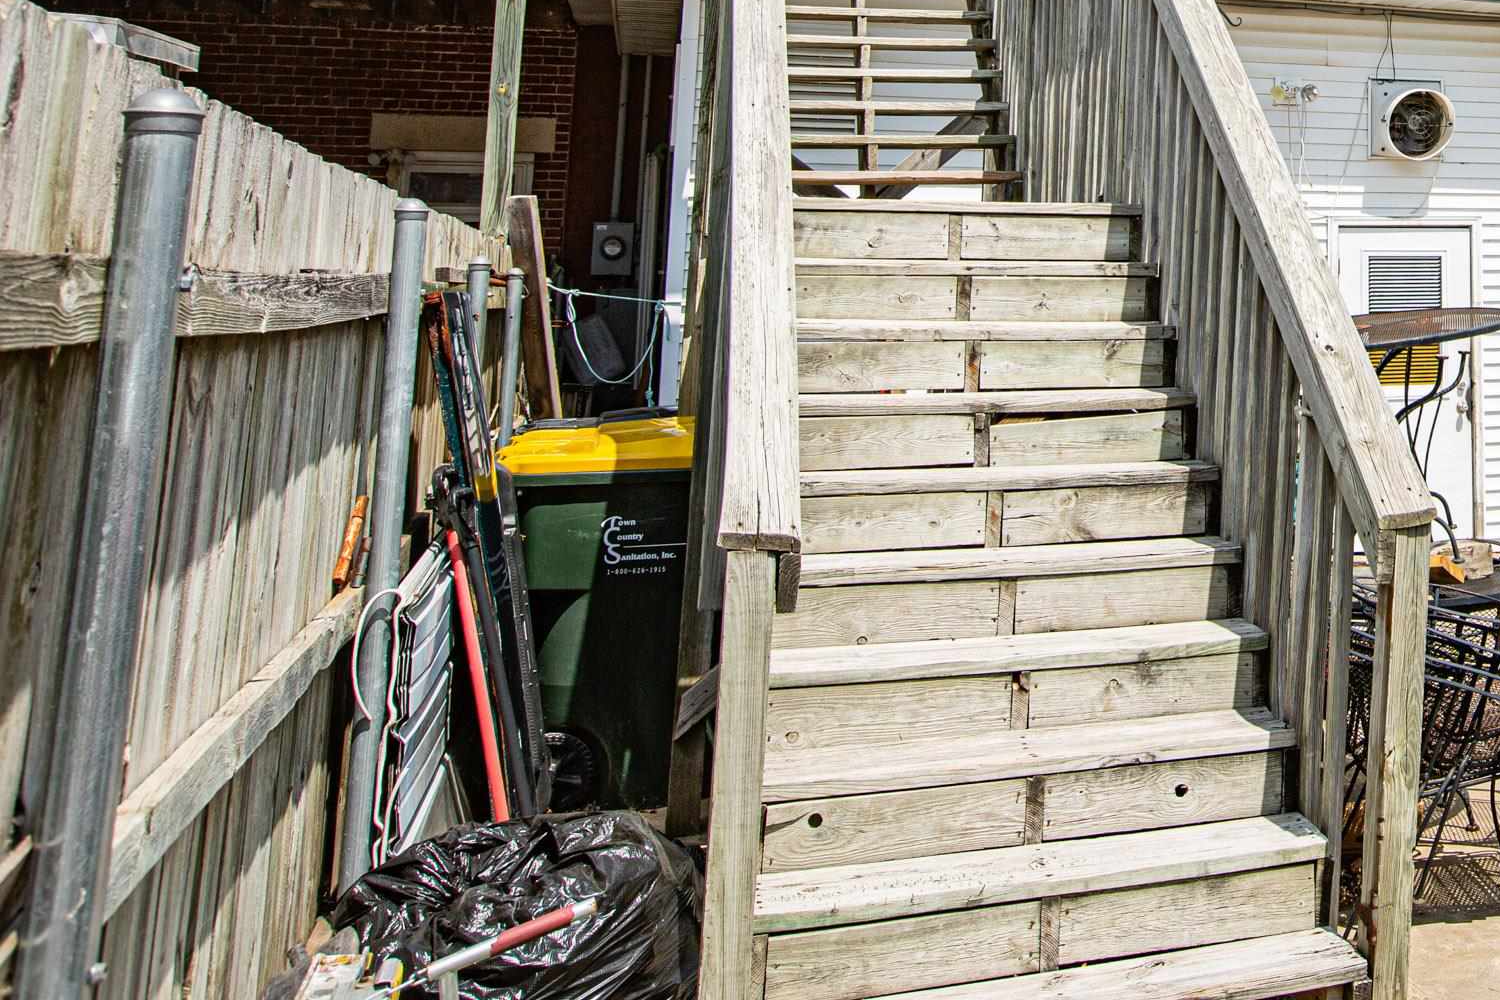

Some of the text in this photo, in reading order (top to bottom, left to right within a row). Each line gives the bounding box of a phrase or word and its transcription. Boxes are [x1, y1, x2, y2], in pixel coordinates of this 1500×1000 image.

[600, 515, 637, 531] Town
[603, 526, 644, 547] Country
[603, 543, 677, 565] Sanitation, Inc.
